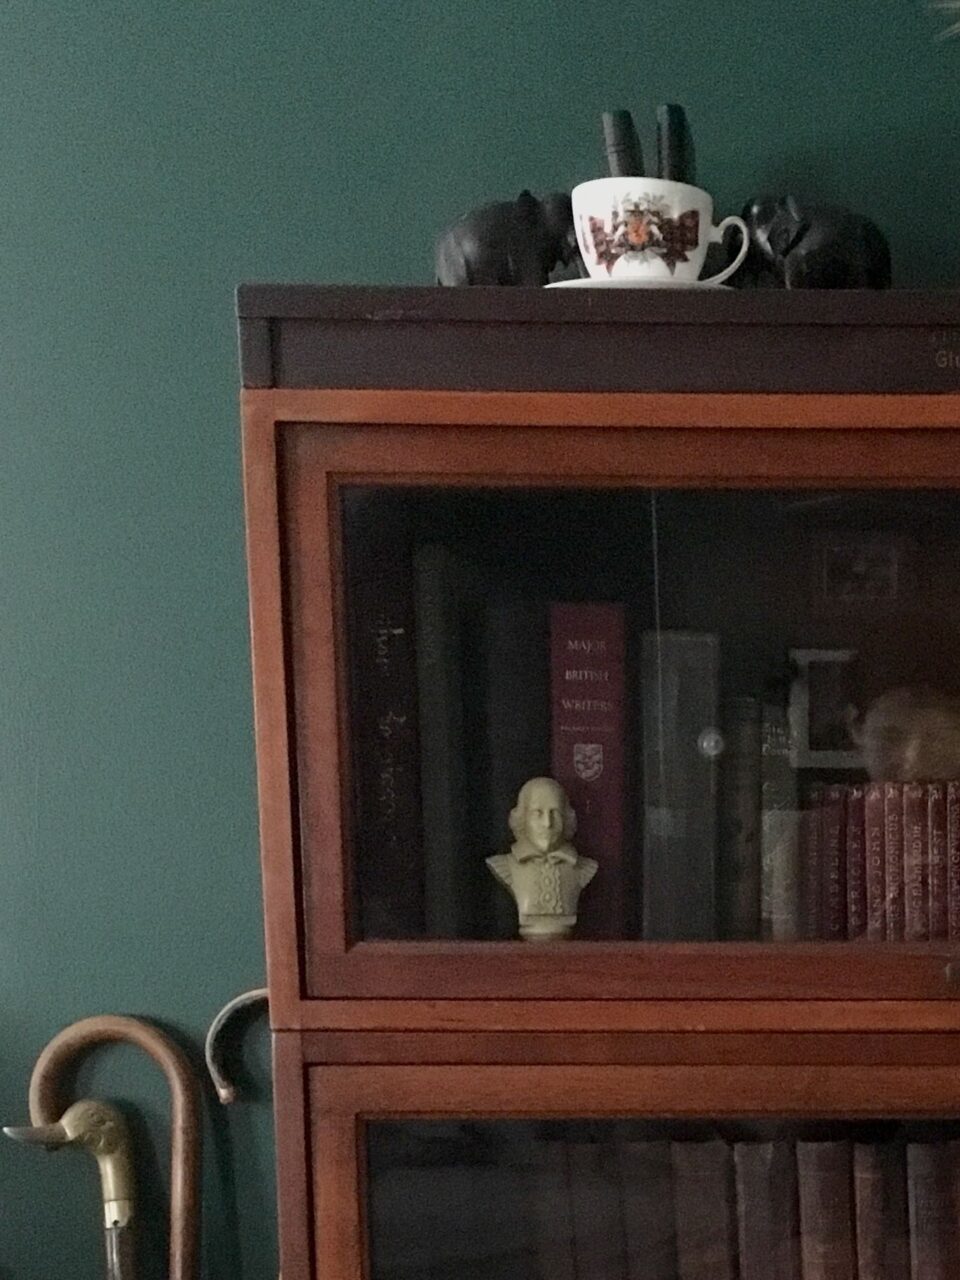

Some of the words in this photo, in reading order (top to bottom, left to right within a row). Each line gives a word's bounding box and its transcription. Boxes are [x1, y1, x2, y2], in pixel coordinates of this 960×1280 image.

[568, 640, 606, 654] MAJOR
[565, 669, 609, 681] BRITISH
[562, 699, 613, 712] WRITERS
[871, 826, 881, 877] JOHN
